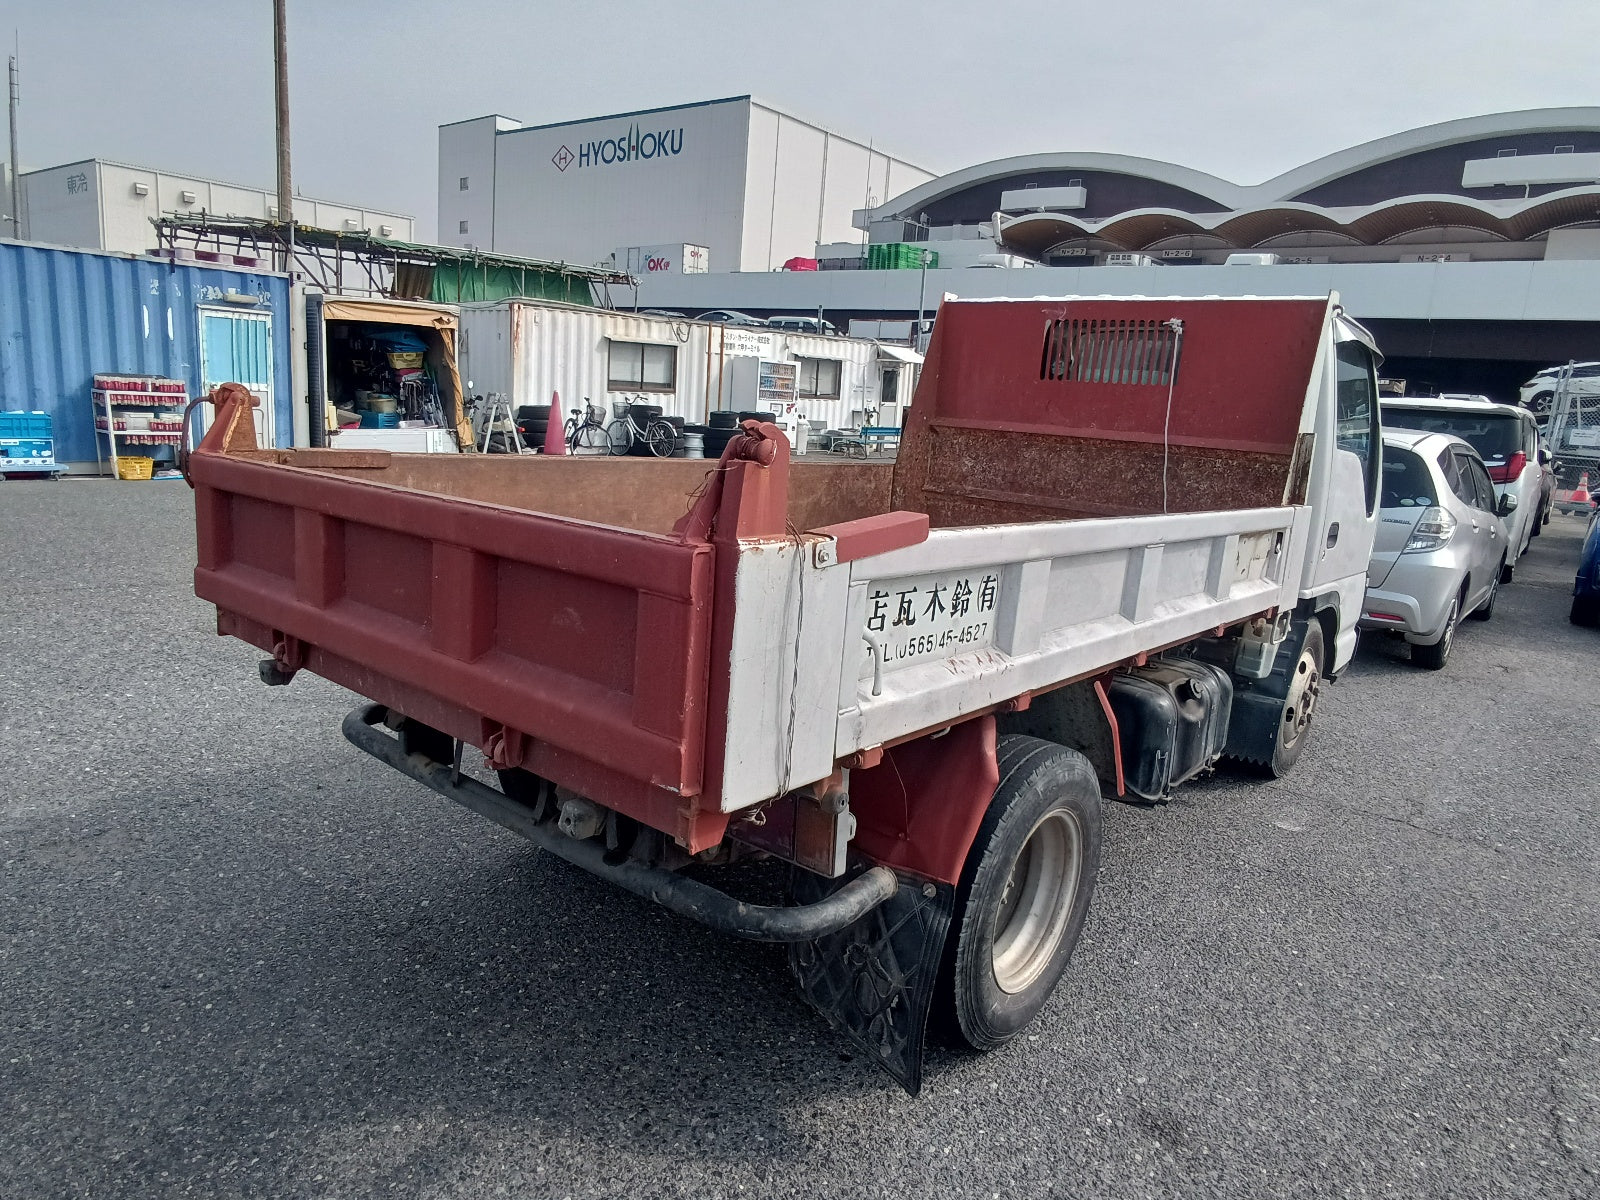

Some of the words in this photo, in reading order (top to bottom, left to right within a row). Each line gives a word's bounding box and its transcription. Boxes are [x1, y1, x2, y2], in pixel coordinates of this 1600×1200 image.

[578, 122, 684, 168] HYOSHOKU
[66, 172, 88, 195] 東冷
[1286, 256, 1313, 264] -2-5
[866, 622, 988, 663] TL.(0565)45-4527
